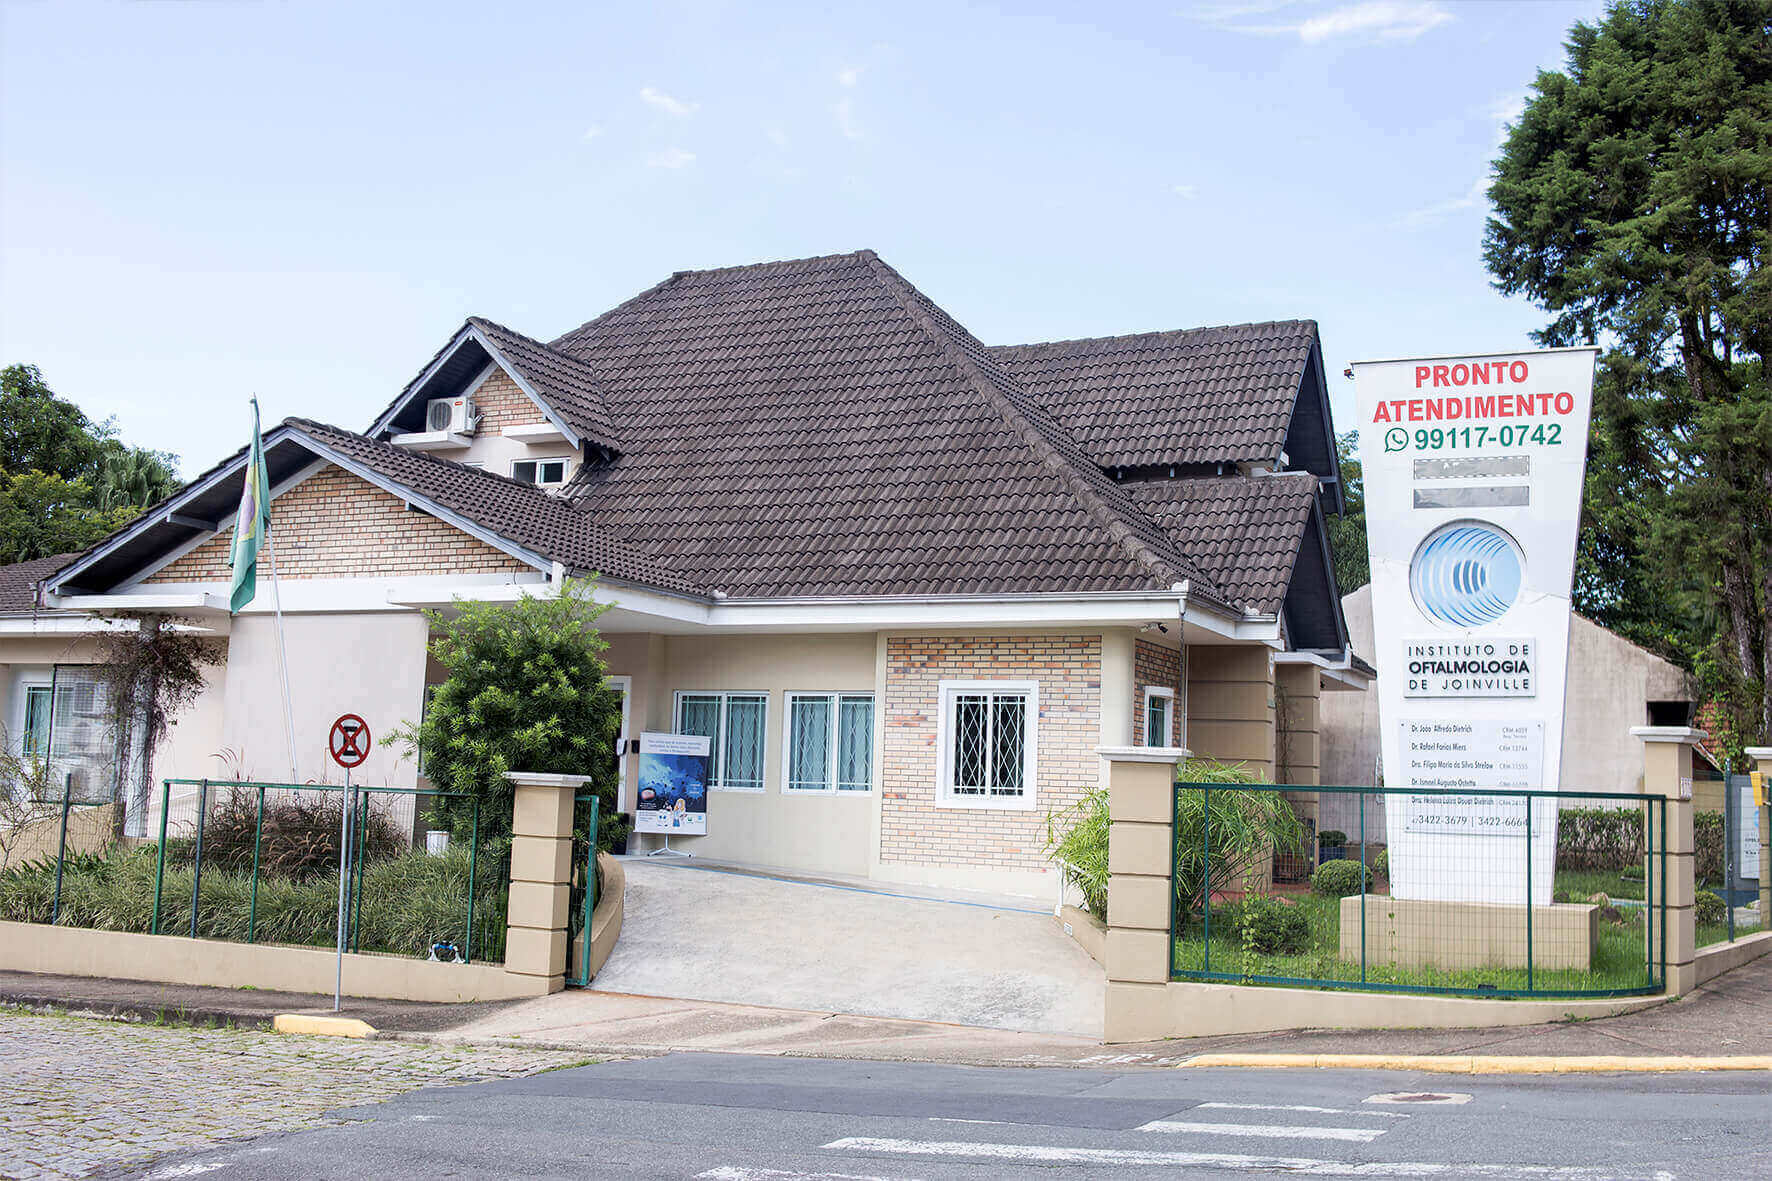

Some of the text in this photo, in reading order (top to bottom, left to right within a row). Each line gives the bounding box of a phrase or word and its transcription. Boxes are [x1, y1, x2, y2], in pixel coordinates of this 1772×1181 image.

[1415, 360, 1529, 389] PRONTO
[1372, 392, 1574, 423] ATENDIMENTO
[1414, 423, 1562, 451] 99117-0742
[1408, 644, 1529, 657] INSTITUTO DE
[1408, 660, 1530, 675] OFTALMOLOGIA
[1409, 678, 1529, 691] DE JOINVILLE
